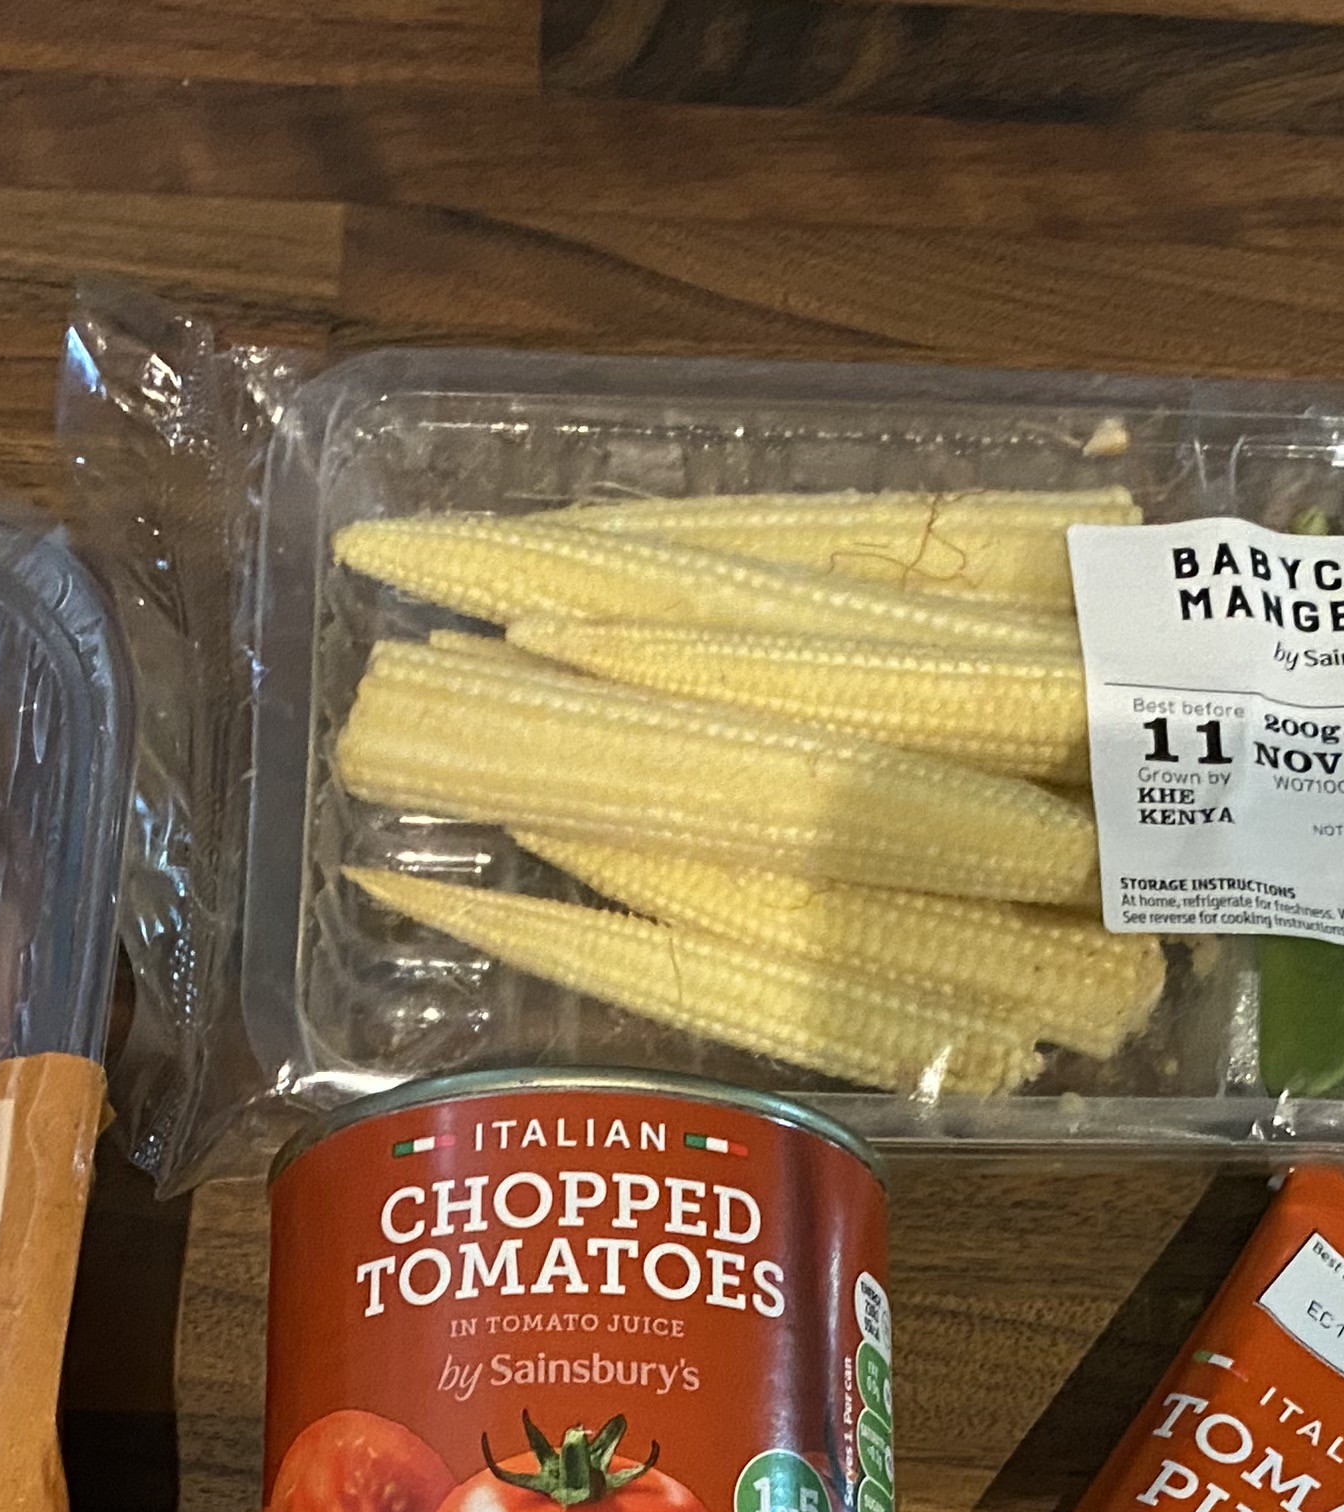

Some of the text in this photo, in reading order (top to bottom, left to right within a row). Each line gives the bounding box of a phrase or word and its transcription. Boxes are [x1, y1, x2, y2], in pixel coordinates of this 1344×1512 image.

[1273, 641, 1298, 671] by
[1133, 697, 1245, 719] Best before
[1143, 717, 1233, 765] 11
[1253, 741, 1343, 775] NOV
[1138, 766, 1231, 785] Grown by
[1137, 787, 1196, 804] KHE
[1139, 806, 1235, 825] KENYA
[1313, 825, 1343, 837] NOT
[1120, 877, 1296, 900] STORAGE INSTRUCTIONS
[1121, 894, 1138, 907] At
[1139, 894, 1181, 909] home,
[1183, 895, 1253, 911] refrigerate
[1255, 897, 1272, 909] for
[1274, 900, 1333, 919] freshness.
[1123, 911, 1146, 924] See
[1149, 912, 1197, 925] reverse
[1199, 912, 1218, 925] for
[1221, 913, 1271, 928] cooking
[474, 1117, 667, 1152] ITALIAN
[380, 1170, 762, 1245] CHOPPED
[1312, 1239, 1343, 1274] Best
[356, 1236, 787, 1319] TOMATOES
[450, 1312, 685, 1338] IN TOMATO JUICE
[436, 1352, 701, 1401] by Sainsbury's
[843, 1356, 854, 1507] Serves Per can
